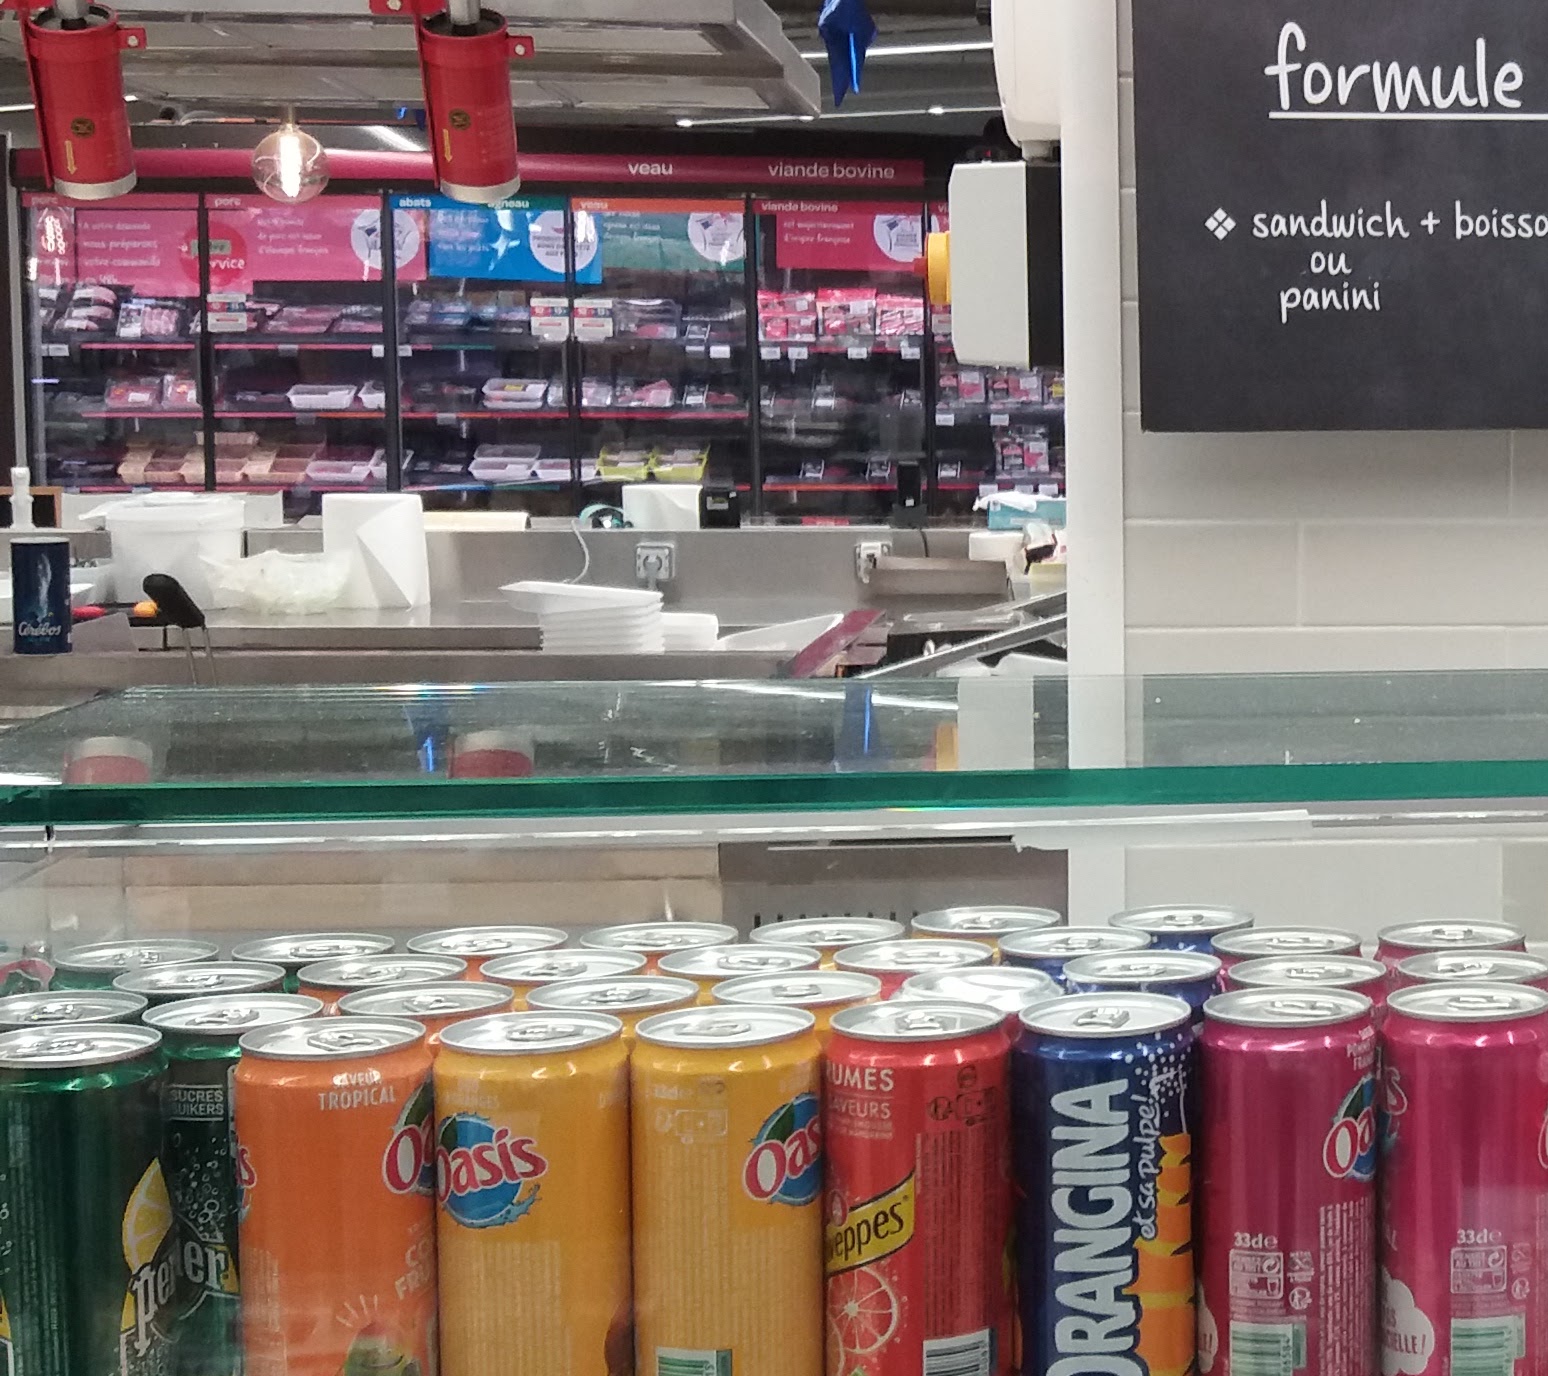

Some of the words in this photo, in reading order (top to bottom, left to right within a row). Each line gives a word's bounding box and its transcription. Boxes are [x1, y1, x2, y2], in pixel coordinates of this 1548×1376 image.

[1265, 22, 1524, 111] formule
[628, 161, 673, 176] veau
[768, 162, 830, 179] viande
[833, 163, 895, 180] bovine
[761, 201, 799, 212] viande
[800, 202, 839, 213] bovine
[1253, 199, 1410, 238] sandwich
[1311, 251, 1352, 275] ou
[1280, 282, 1380, 324] panini
[318, 1085, 397, 1112] TROPICAL
[435, 1128, 549, 1204] Oasis
[834, 1202, 905, 1262] eppes
